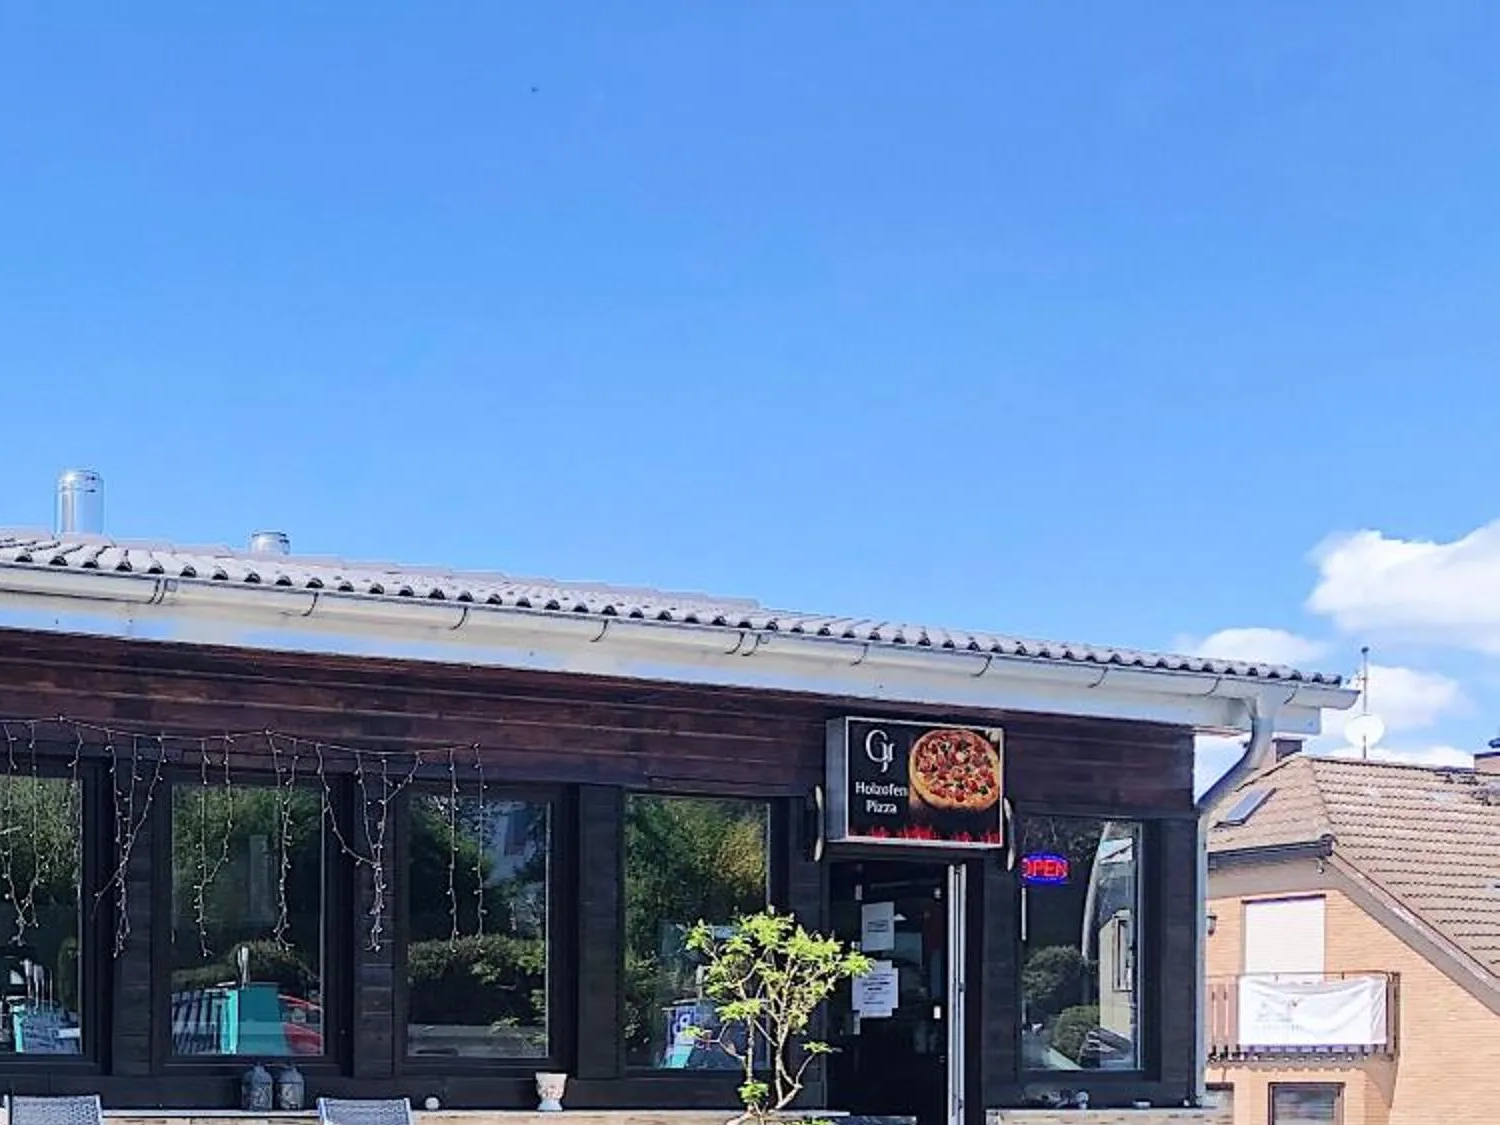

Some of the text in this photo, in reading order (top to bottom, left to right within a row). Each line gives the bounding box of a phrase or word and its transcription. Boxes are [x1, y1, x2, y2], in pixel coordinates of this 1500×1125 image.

[855, 781, 908, 797] Holzofen
[866, 800, 897, 814] Pizza
[1023, 859, 1068, 877] OPEN
